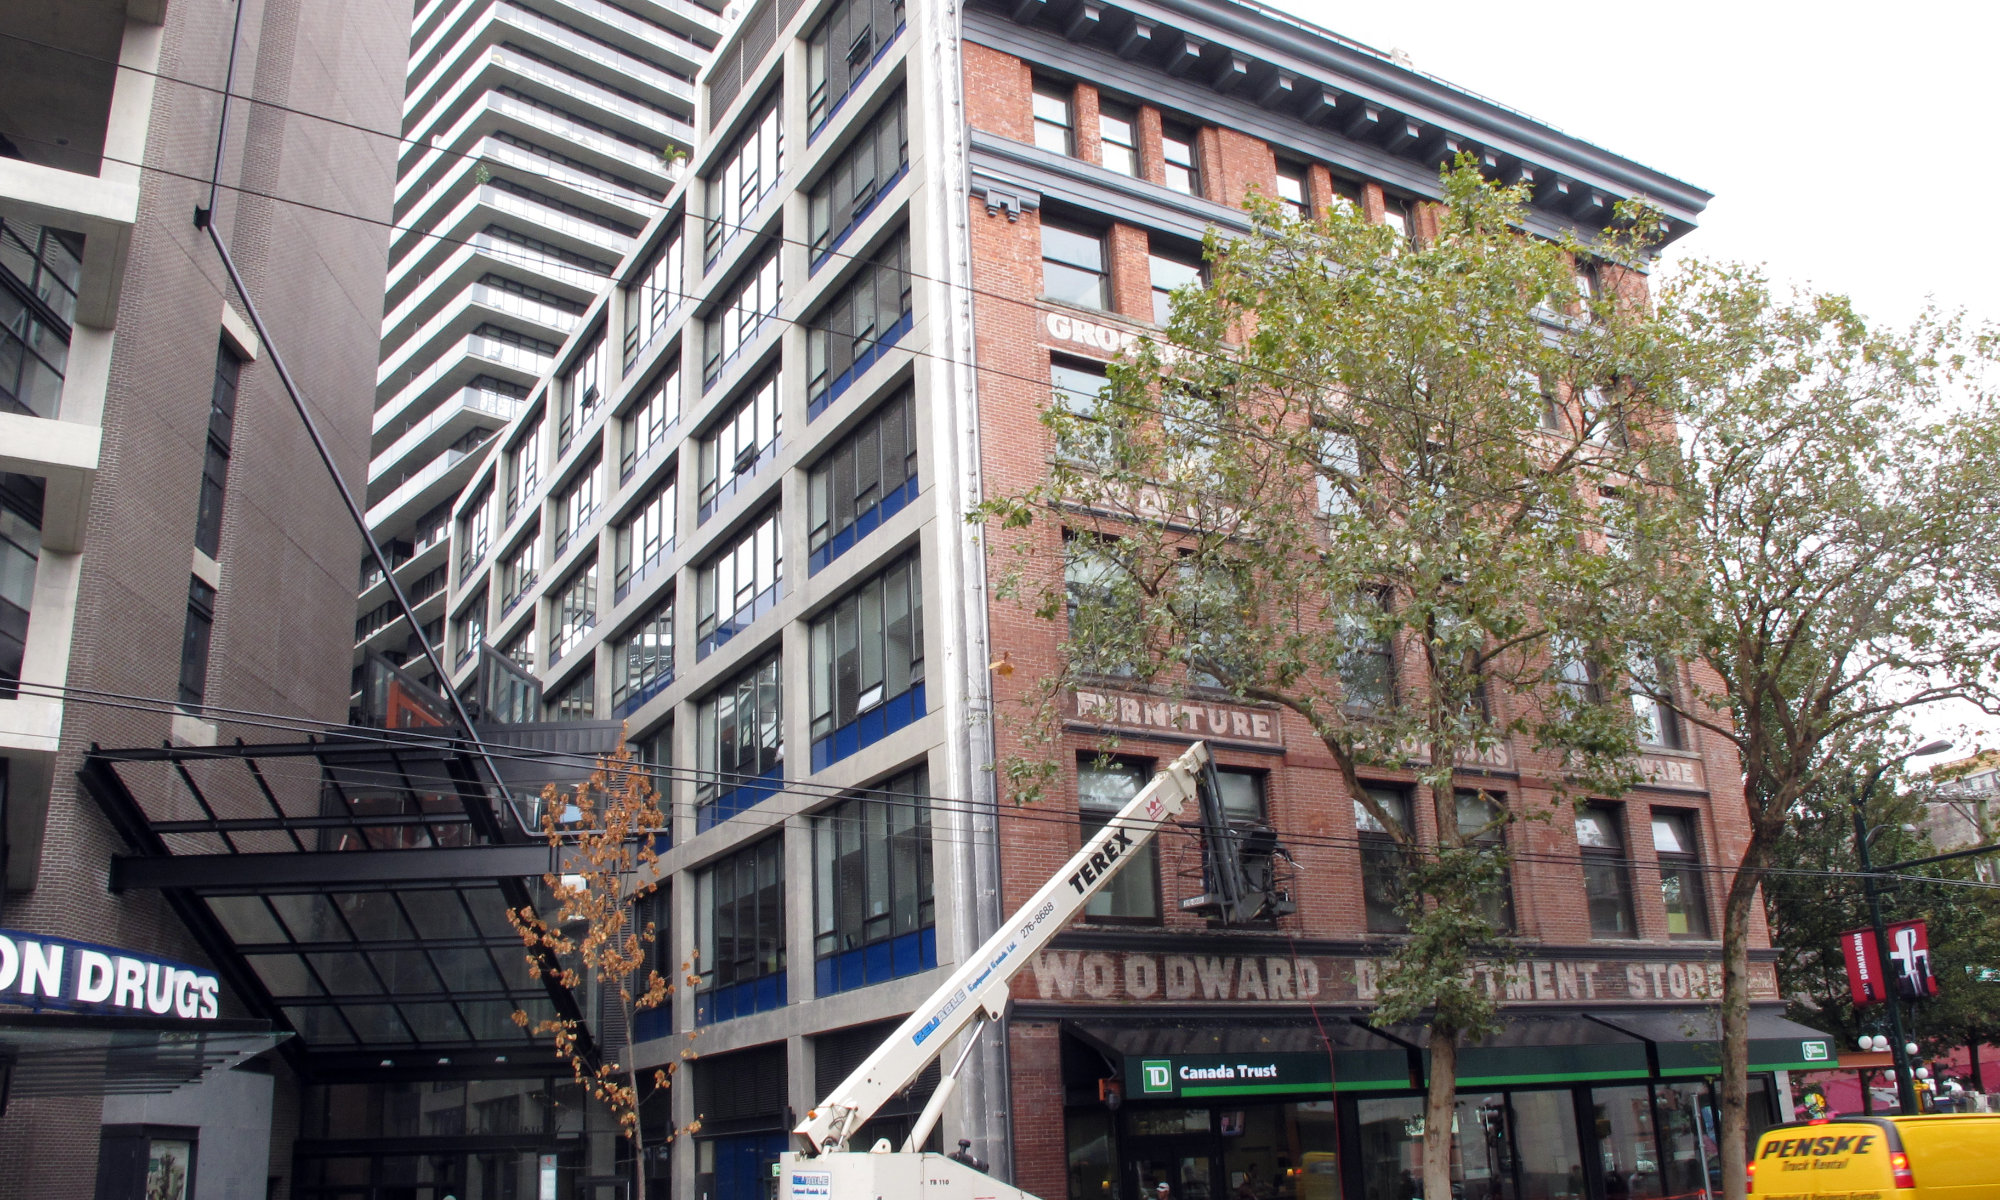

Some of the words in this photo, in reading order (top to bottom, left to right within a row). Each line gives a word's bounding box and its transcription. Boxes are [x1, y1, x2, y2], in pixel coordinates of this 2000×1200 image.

[1068, 827, 1133, 895] TEREX
[1020, 901, 1055, 939] 276-8688
[72, 950, 219, 1018] DRUGS
[1031, 951, 1320, 1000] WOODWARD
[912, 988, 967, 1047] RELIABLE
[1145, 1066, 1169, 1086] TD
[1179, 1064, 1235, 1080] Canada
[1237, 1063, 1277, 1078] Trust
[1761, 1134, 1876, 1160] PENSKE
[1781, 1159, 1811, 1172] Truck
[1812, 1158, 1849, 1171] Rental
